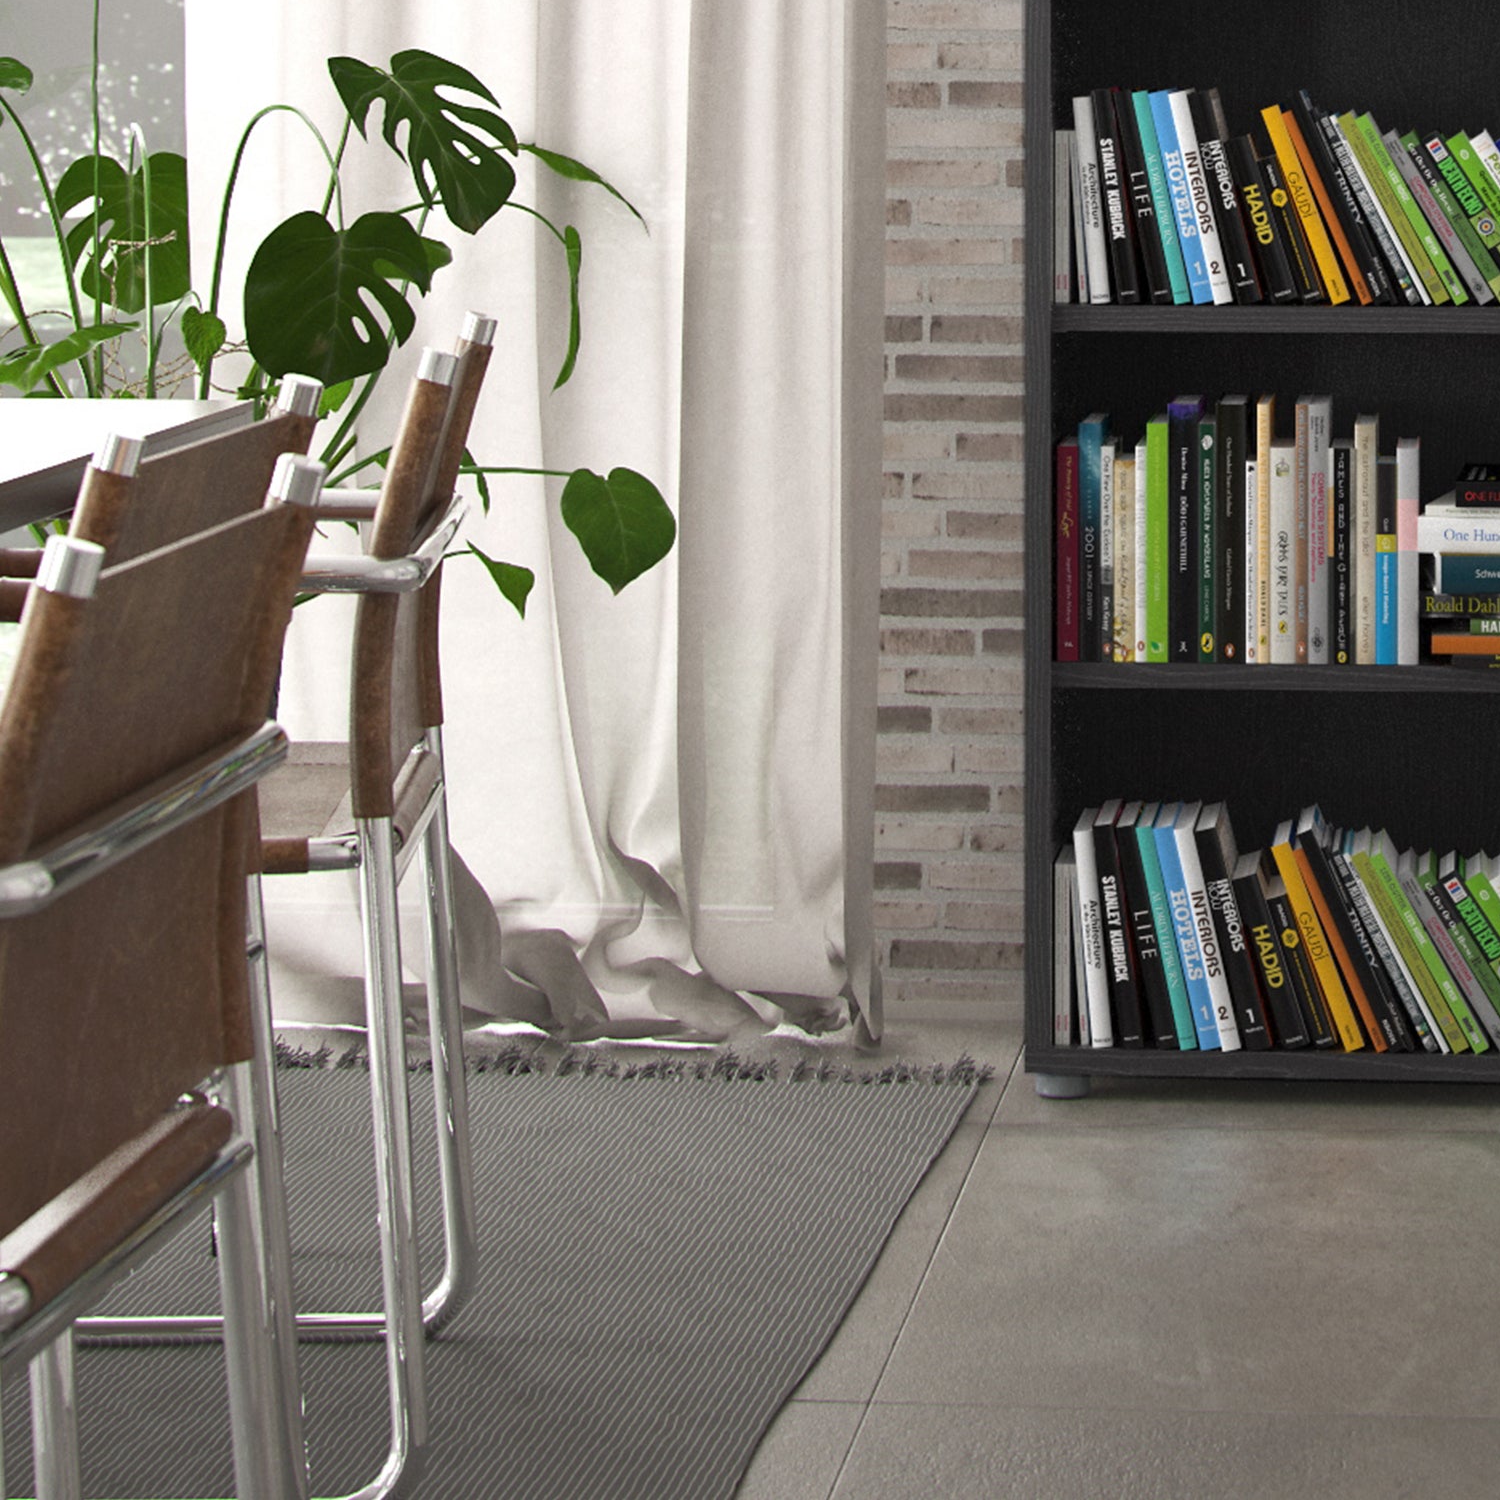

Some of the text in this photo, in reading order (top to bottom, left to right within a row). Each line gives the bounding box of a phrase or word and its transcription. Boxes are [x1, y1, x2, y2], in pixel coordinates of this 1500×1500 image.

[1087, 163, 1099, 228] Architecture
[1100, 138, 1126, 241] STANLEY KUBRICK
[1130, 171, 1153, 218] LIFE
[1164, 150, 1196, 238] HOTELS
[1209, 140, 1237, 210] INTERIORS
[1287, 171, 1317, 219] GAUDÍ
[1334, 168, 1364, 225] TRINITY
[1436, 155, 1484, 216] DEATH ECHO
[1185, 151, 1221, 275] INTERIORS 2
[1243, 183, 1274, 245] HADID
[1337, 452, 1346, 499] JAMES
[1465, 491, 1486, 500] ONE
[1085, 525, 1095, 558] 2001
[1317, 524, 1325, 565] SYSTEMS
[1337, 503, 1346, 529] AND
[1443, 528, 1470, 541] One
[1425, 596, 1463, 613] Roald
[1468, 596, 1500, 613] Dahl
[1089, 900, 1102, 969] Architecture
[1101, 875, 1129, 983] STANLEY KUBRICK
[1133, 910, 1157, 960] LIFE
[1170, 889, 1203, 981] HOTELS
[1216, 879, 1245, 952] INTERIORS
[1299, 911, 1328, 961] GAUDÍ
[1349, 909, 1379, 969] TRINITY
[1455, 896, 1489, 935] DEATH
[1191, 891, 1229, 1021] INTERIORS 2
[1252, 925, 1284, 988] HADID
